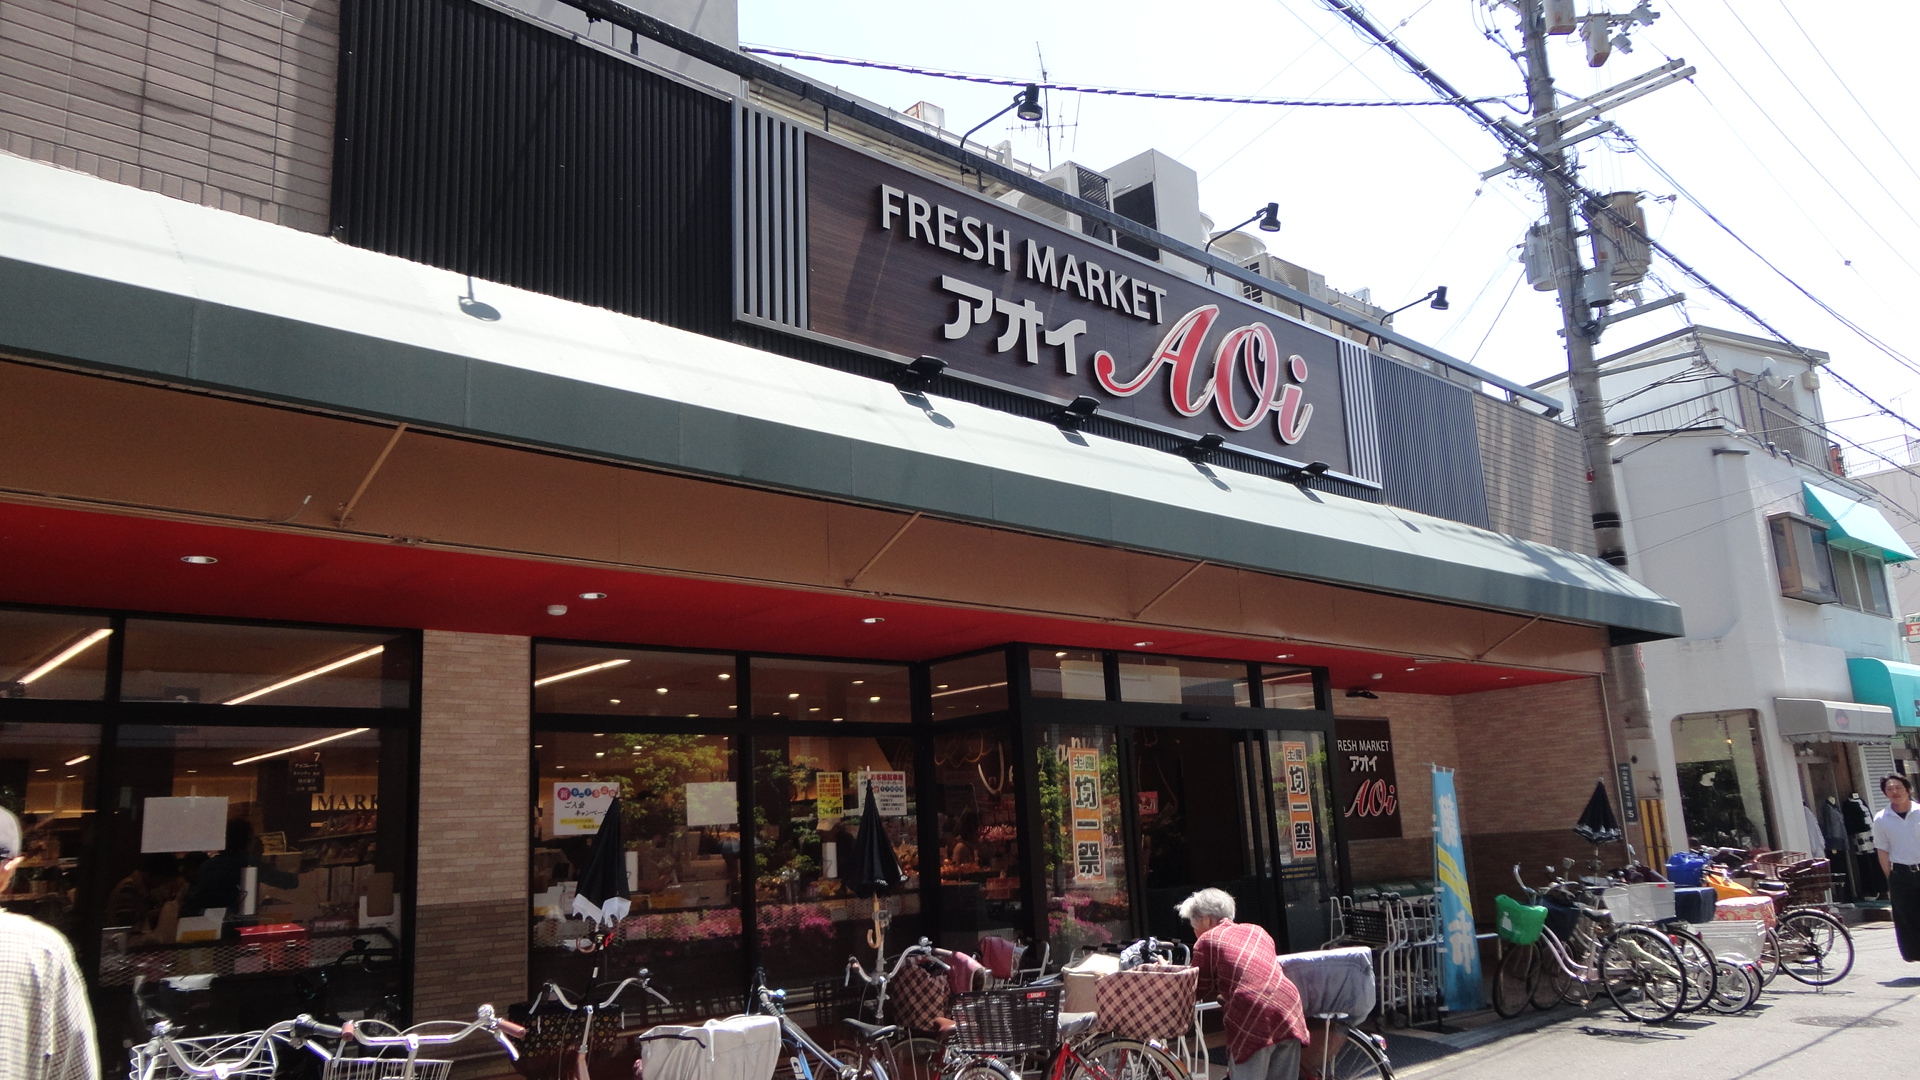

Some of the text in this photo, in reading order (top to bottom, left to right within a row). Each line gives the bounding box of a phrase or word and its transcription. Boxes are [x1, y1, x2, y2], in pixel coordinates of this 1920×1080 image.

[882, 184, 1167, 325] FRESH MARKET
[941, 275, 1088, 376] アオイ
[1337, 740, 1390, 752] RESH MARKET
[1349, 754, 1378, 772] アオイ
